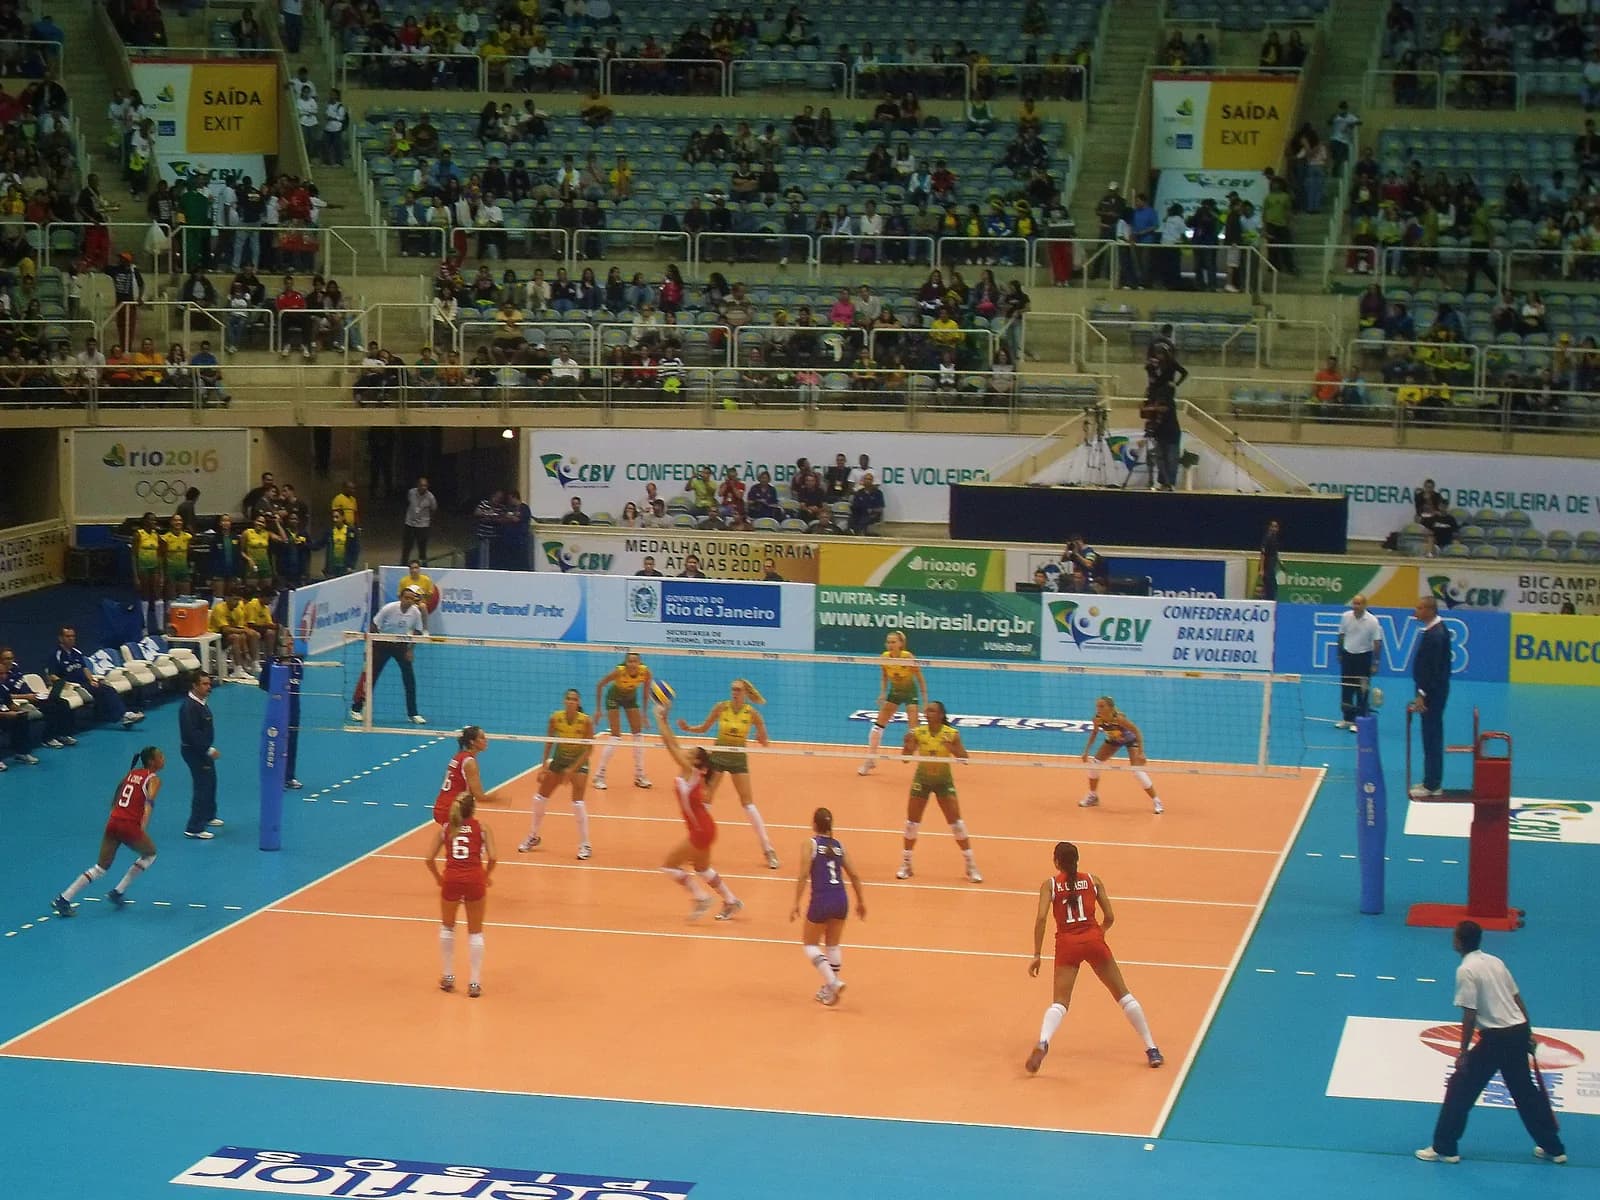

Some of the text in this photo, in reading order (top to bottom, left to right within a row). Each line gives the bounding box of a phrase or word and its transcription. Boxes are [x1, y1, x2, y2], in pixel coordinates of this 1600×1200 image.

[203, 87, 263, 106] SAÍDA
[1221, 100, 1280, 120] SAÍDA
[204, 116, 243, 131] EXIT
[1221, 130, 1260, 145] EXIT
[578, 464, 616, 482] CBV
[625, 461, 770, 483] CONFEDERAÃO
[881, 467, 905, 484] DE
[1456, 488, 1560, 512] BRASILEIRA
[1566, 494, 1590, 514] DE
[625, 539, 701, 556] MEDALHA
[706, 542, 750, 558] OURO
[764, 544, 815, 560] PRAIA
[577, 553, 615, 571] CBV
[665, 556, 763, 574] ATNAS 200
[1518, 575, 1600, 591] BICAMP
[1465, 588, 1507, 608] CBV
[487, 602, 530, 616] Grand
[665, 603, 776, 620] Rio de Janeiro
[1162, 604, 1270, 624] CONFEDERAÇÃO
[819, 611, 1036, 637] www.voleibrasil.org.br
[1100, 617, 1153, 642] CBV
[1177, 626, 1255, 643] BRASILEIRA
[1172, 647, 1259, 664] DE VOLEIBOL
[118, 783, 134, 808] 9
[452, 836, 470, 860] 6
[826, 860, 840, 885] 1
[1062, 894, 1088, 924] 11
[253, 1151, 651, 1190] PISOS
